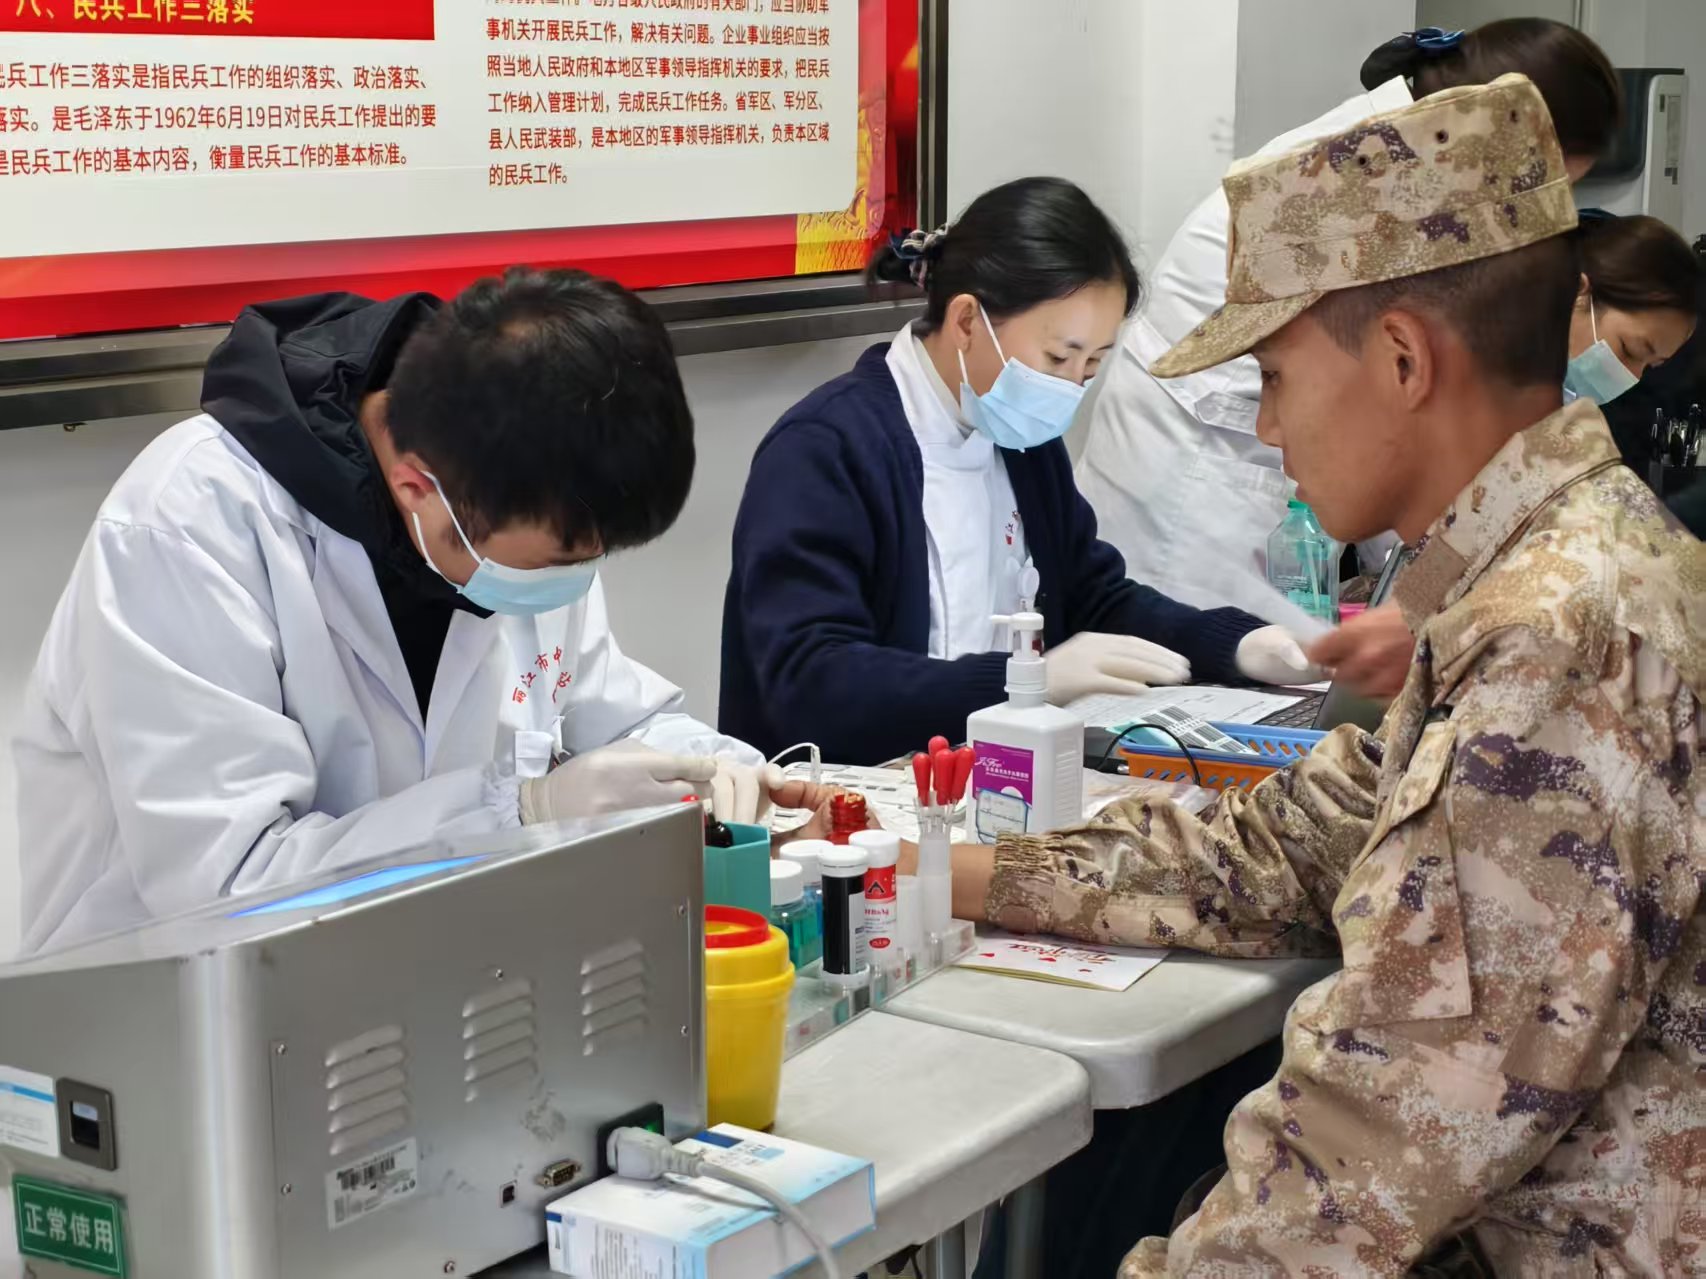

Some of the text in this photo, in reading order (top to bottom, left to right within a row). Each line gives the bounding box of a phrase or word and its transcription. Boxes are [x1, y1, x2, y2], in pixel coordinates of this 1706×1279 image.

[17, 0, 253, 23] 八、民兵工作三落实
[487, 18, 829, 45] 事机关开展民兵工作，解决有关问题。企业事业组织应当按
[488, 55, 829, 78] 照当地人民政府和本地区军事领导指挥机关的要求，把民兵
[488, 91, 822, 113] 工作纳入管理计划，完成民兵工作任务。省军区、军分区、
[489, 123, 829, 149] 县人民武装部，是本地区的军事领导指挥机关，负责本区域
[490, 163, 567, 185] 的民兵工作。
[24, 1202, 113, 1254] 正常使用
